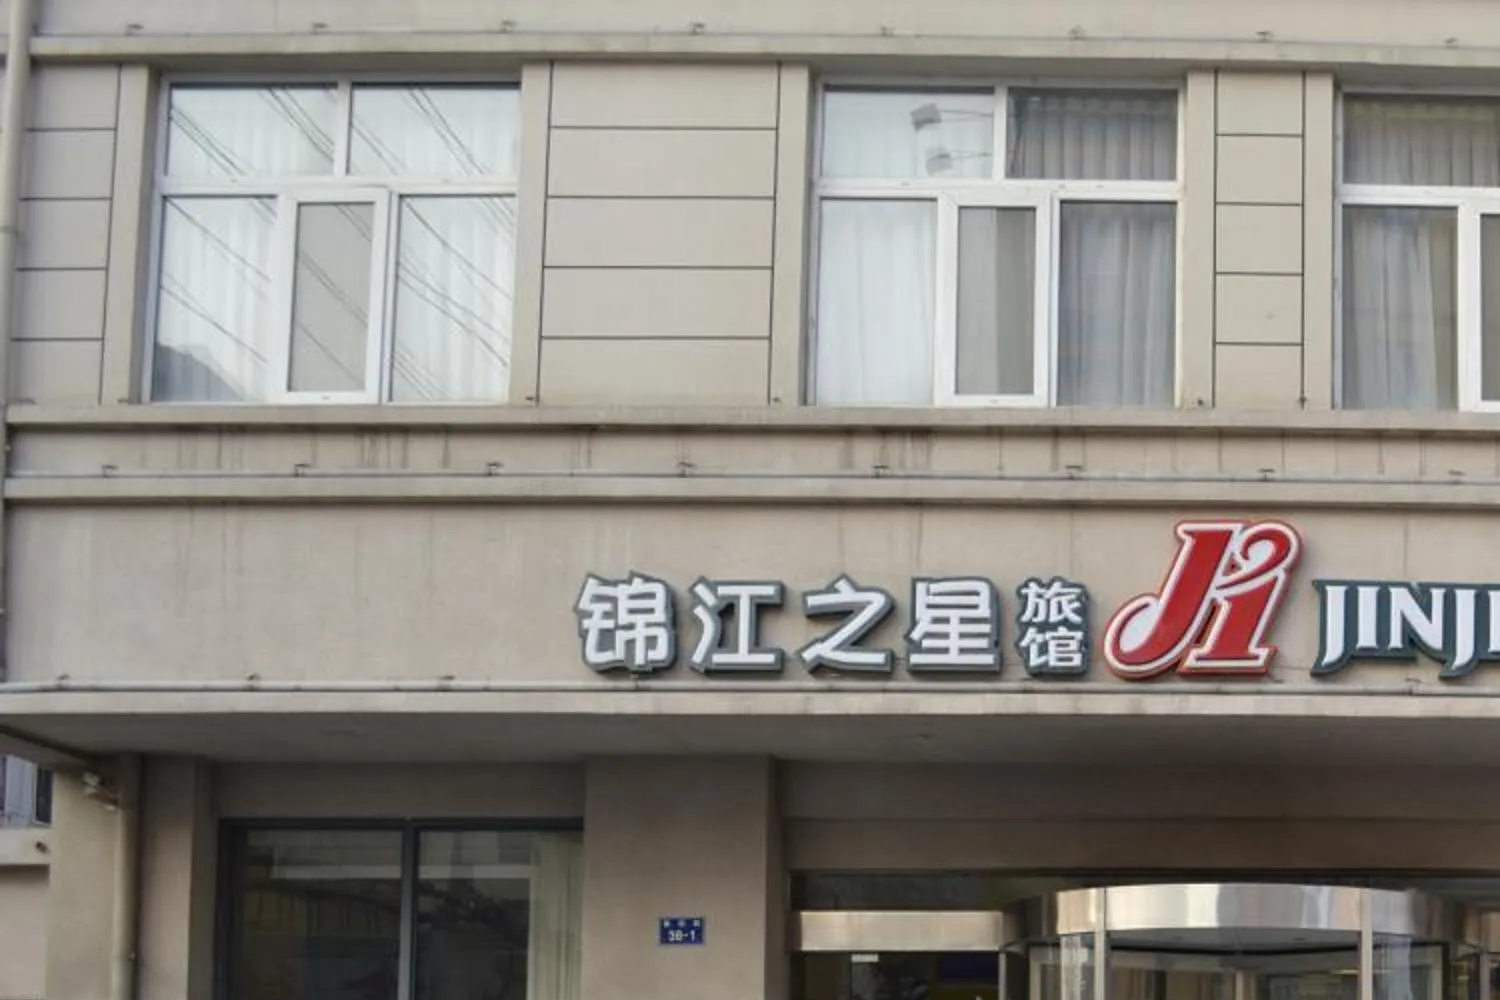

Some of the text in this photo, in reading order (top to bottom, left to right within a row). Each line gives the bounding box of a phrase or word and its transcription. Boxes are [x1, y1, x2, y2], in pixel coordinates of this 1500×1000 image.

[576, 575, 996, 668] 锦江之星
[1019, 579, 1086, 670] 旅馆
